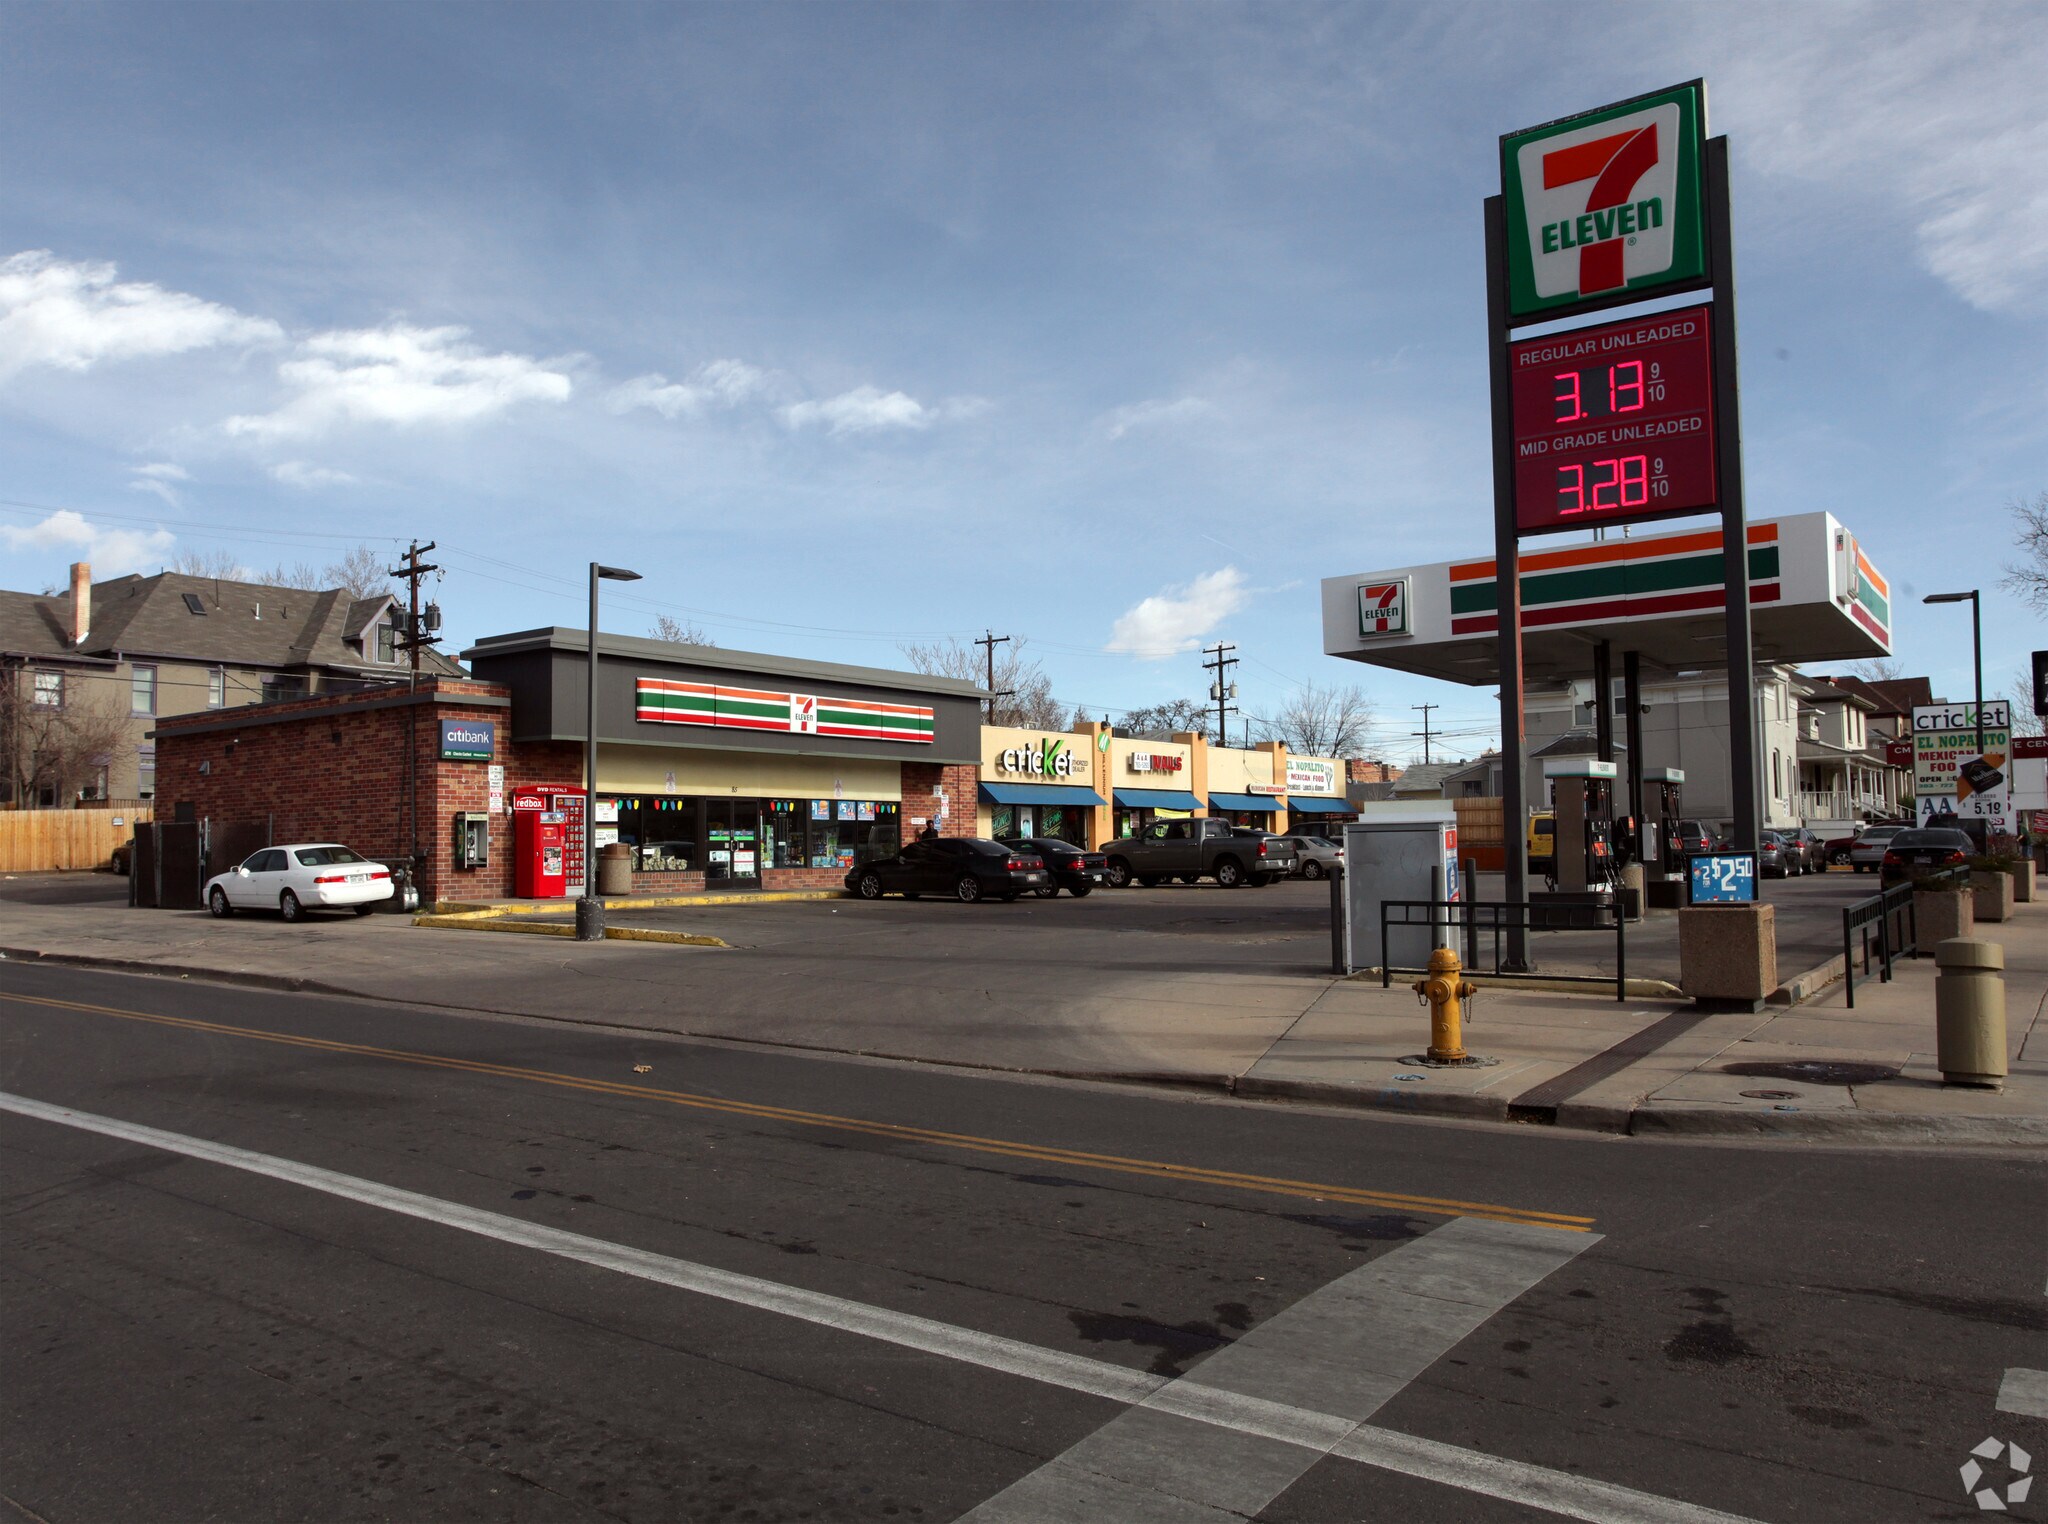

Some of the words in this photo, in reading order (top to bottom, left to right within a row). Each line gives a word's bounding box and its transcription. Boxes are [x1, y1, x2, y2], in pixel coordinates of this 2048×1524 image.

[1542, 122, 1659, 295] 7
[1519, 340, 1597, 366] REGULAR
[1601, 321, 1696, 351] UNLEADED
[1650, 362, 1660, 379] 9
[1554, 360, 1644, 423] 3.13
[1648, 384, 1666, 402] 10
[1519, 440, 1549, 457] MID
[1552, 431, 1607, 452] GRADE
[1611, 416, 1703, 443] UNLEADED
[1653, 457, 1664, 474] 9
[1558, 455, 1648, 515] 3.28
[1651, 480, 1670, 498] 10
[1365, 584, 1397, 632] 7
[795, 696, 813, 731] 7
[1916, 703, 2005, 729] cricket
[447, 729, 490, 744] citibank
[1917, 736, 1934, 749] EL
[1938, 733, 2006, 749] NOPAITO
[1152, 754, 1183, 772] NAILS
[1295, 761, 1325, 773] NOPALITO
[1290, 773, 1311, 781] MEXICAN
[1312, 774, 1325, 783] FOOD
[516, 799, 542, 808] redbox
[1974, 801, 2001, 815] 5.19
[1702, 865, 1710, 880] 2
